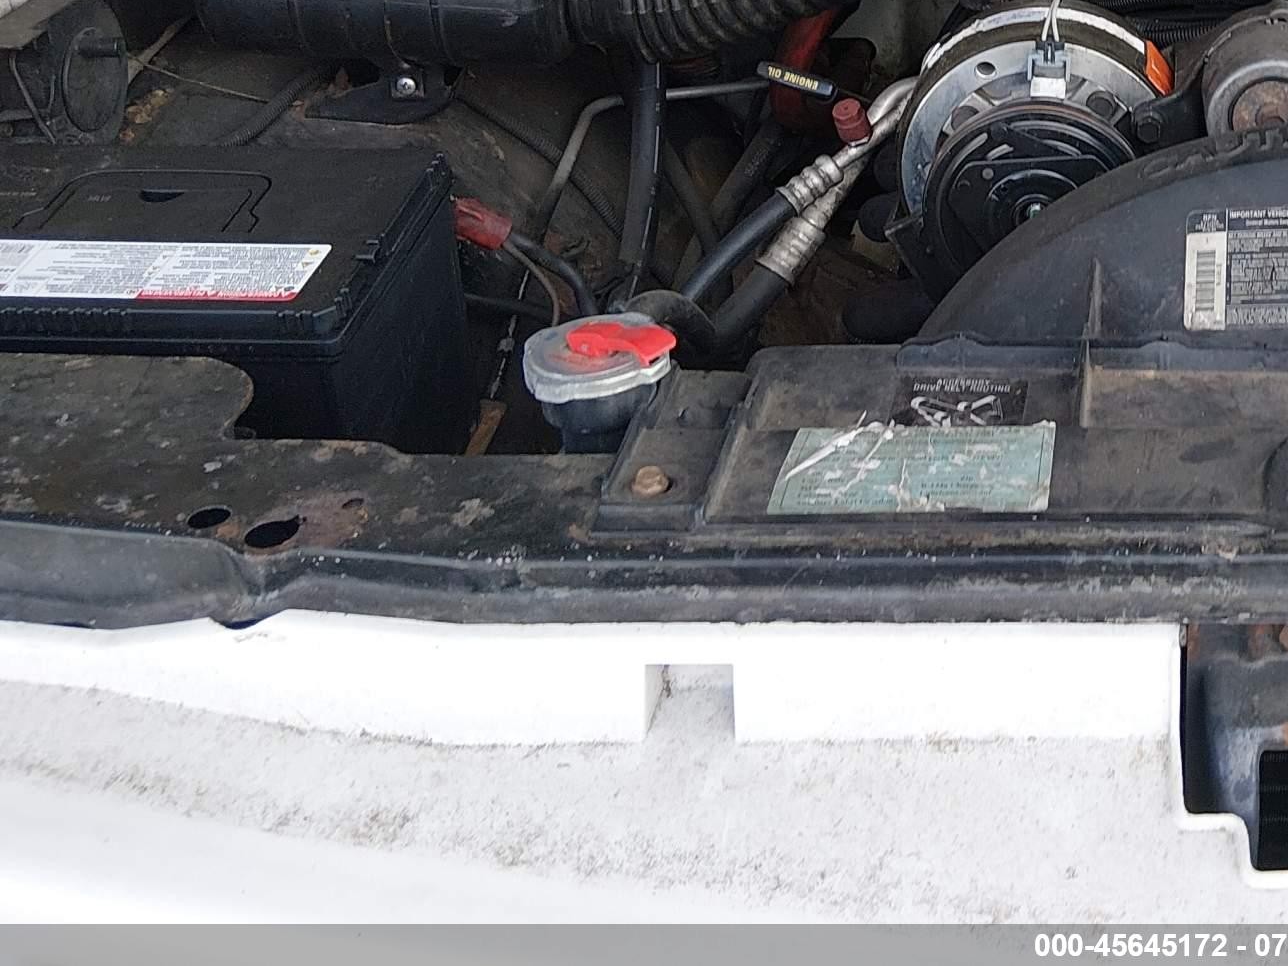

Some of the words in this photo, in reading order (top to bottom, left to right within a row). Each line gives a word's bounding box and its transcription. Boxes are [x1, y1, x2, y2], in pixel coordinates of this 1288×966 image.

[767, 65, 783, 79] OIL
[783, 71, 819, 91] ENGINE
[1229, 209, 1266, 219] IMPORTANT
